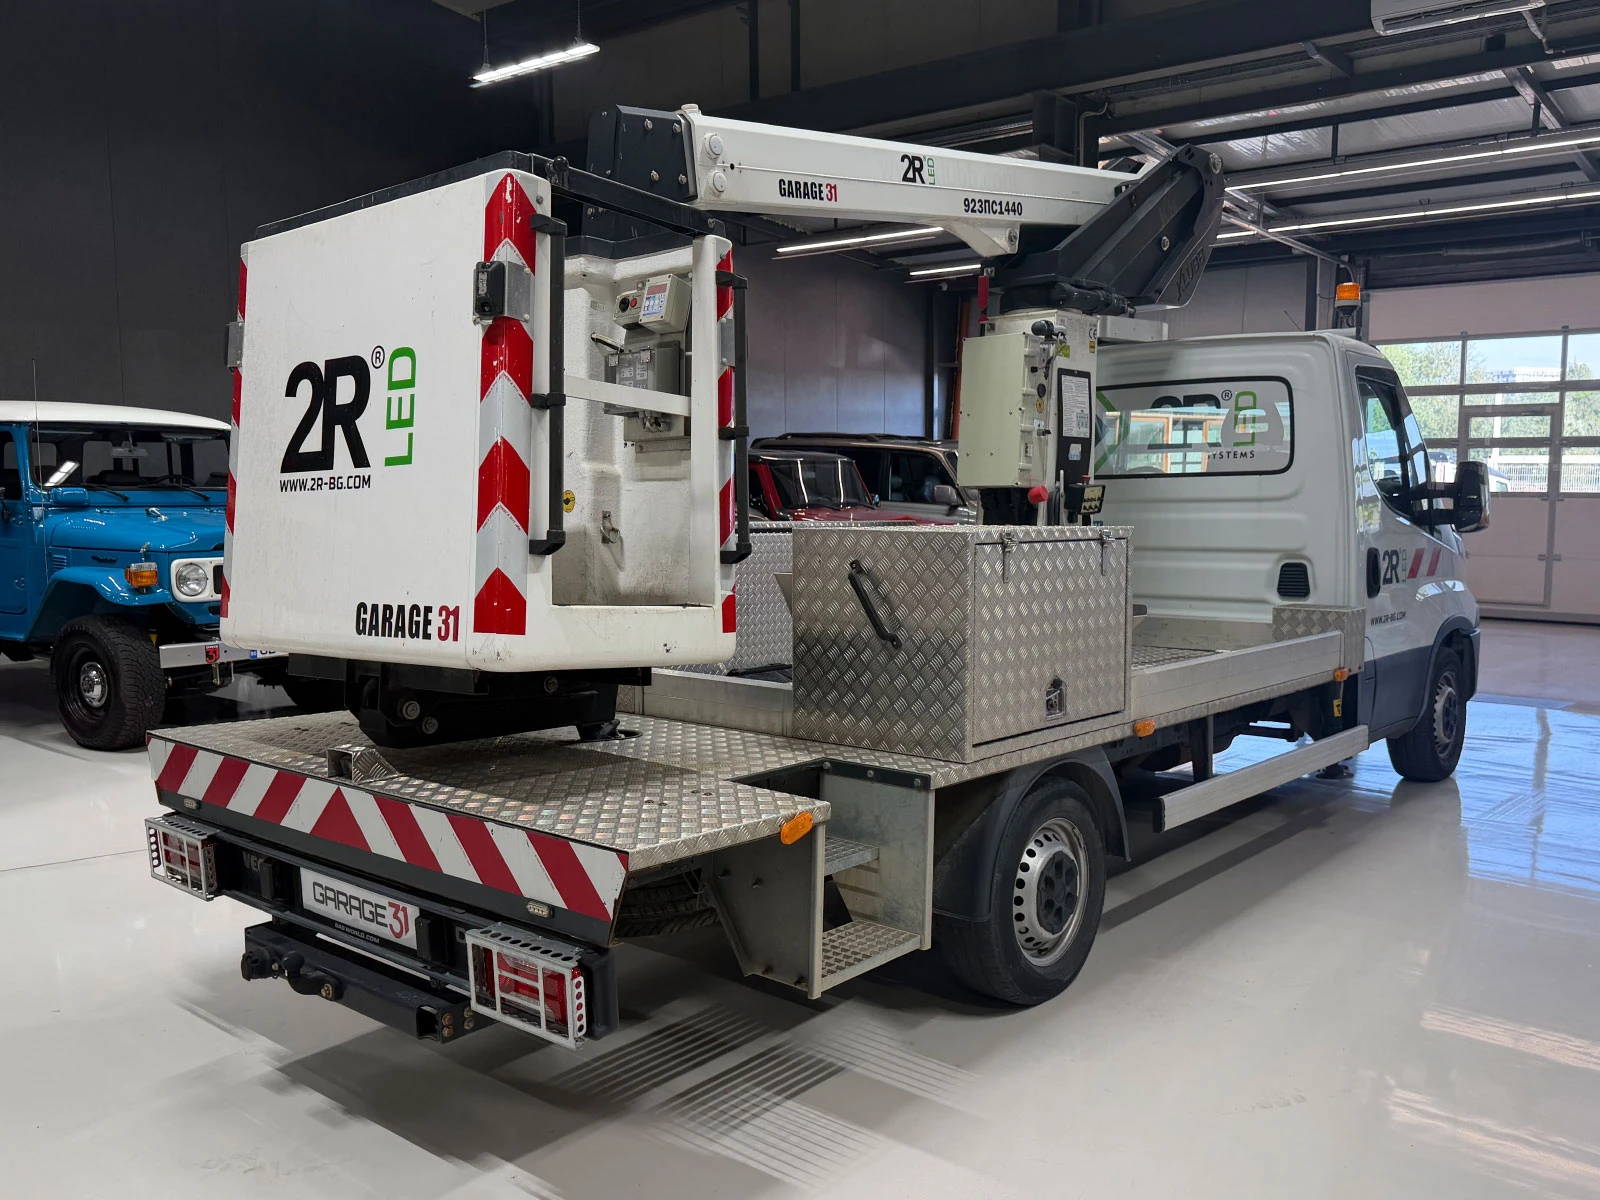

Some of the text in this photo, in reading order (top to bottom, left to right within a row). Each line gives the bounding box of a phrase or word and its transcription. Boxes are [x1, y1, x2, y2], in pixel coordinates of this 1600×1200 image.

[927, 157, 936, 186] LED
[778, 178, 838, 202] GARAGE 31
[384, 346, 417, 467] LED
[1207, 450, 1255, 460] YSTEMS
[280, 475, 371, 492] WWW.2R-BG.COM
[355, 602, 460, 642] GARAGE 31
[312, 881, 409, 939] GARAGE 31
